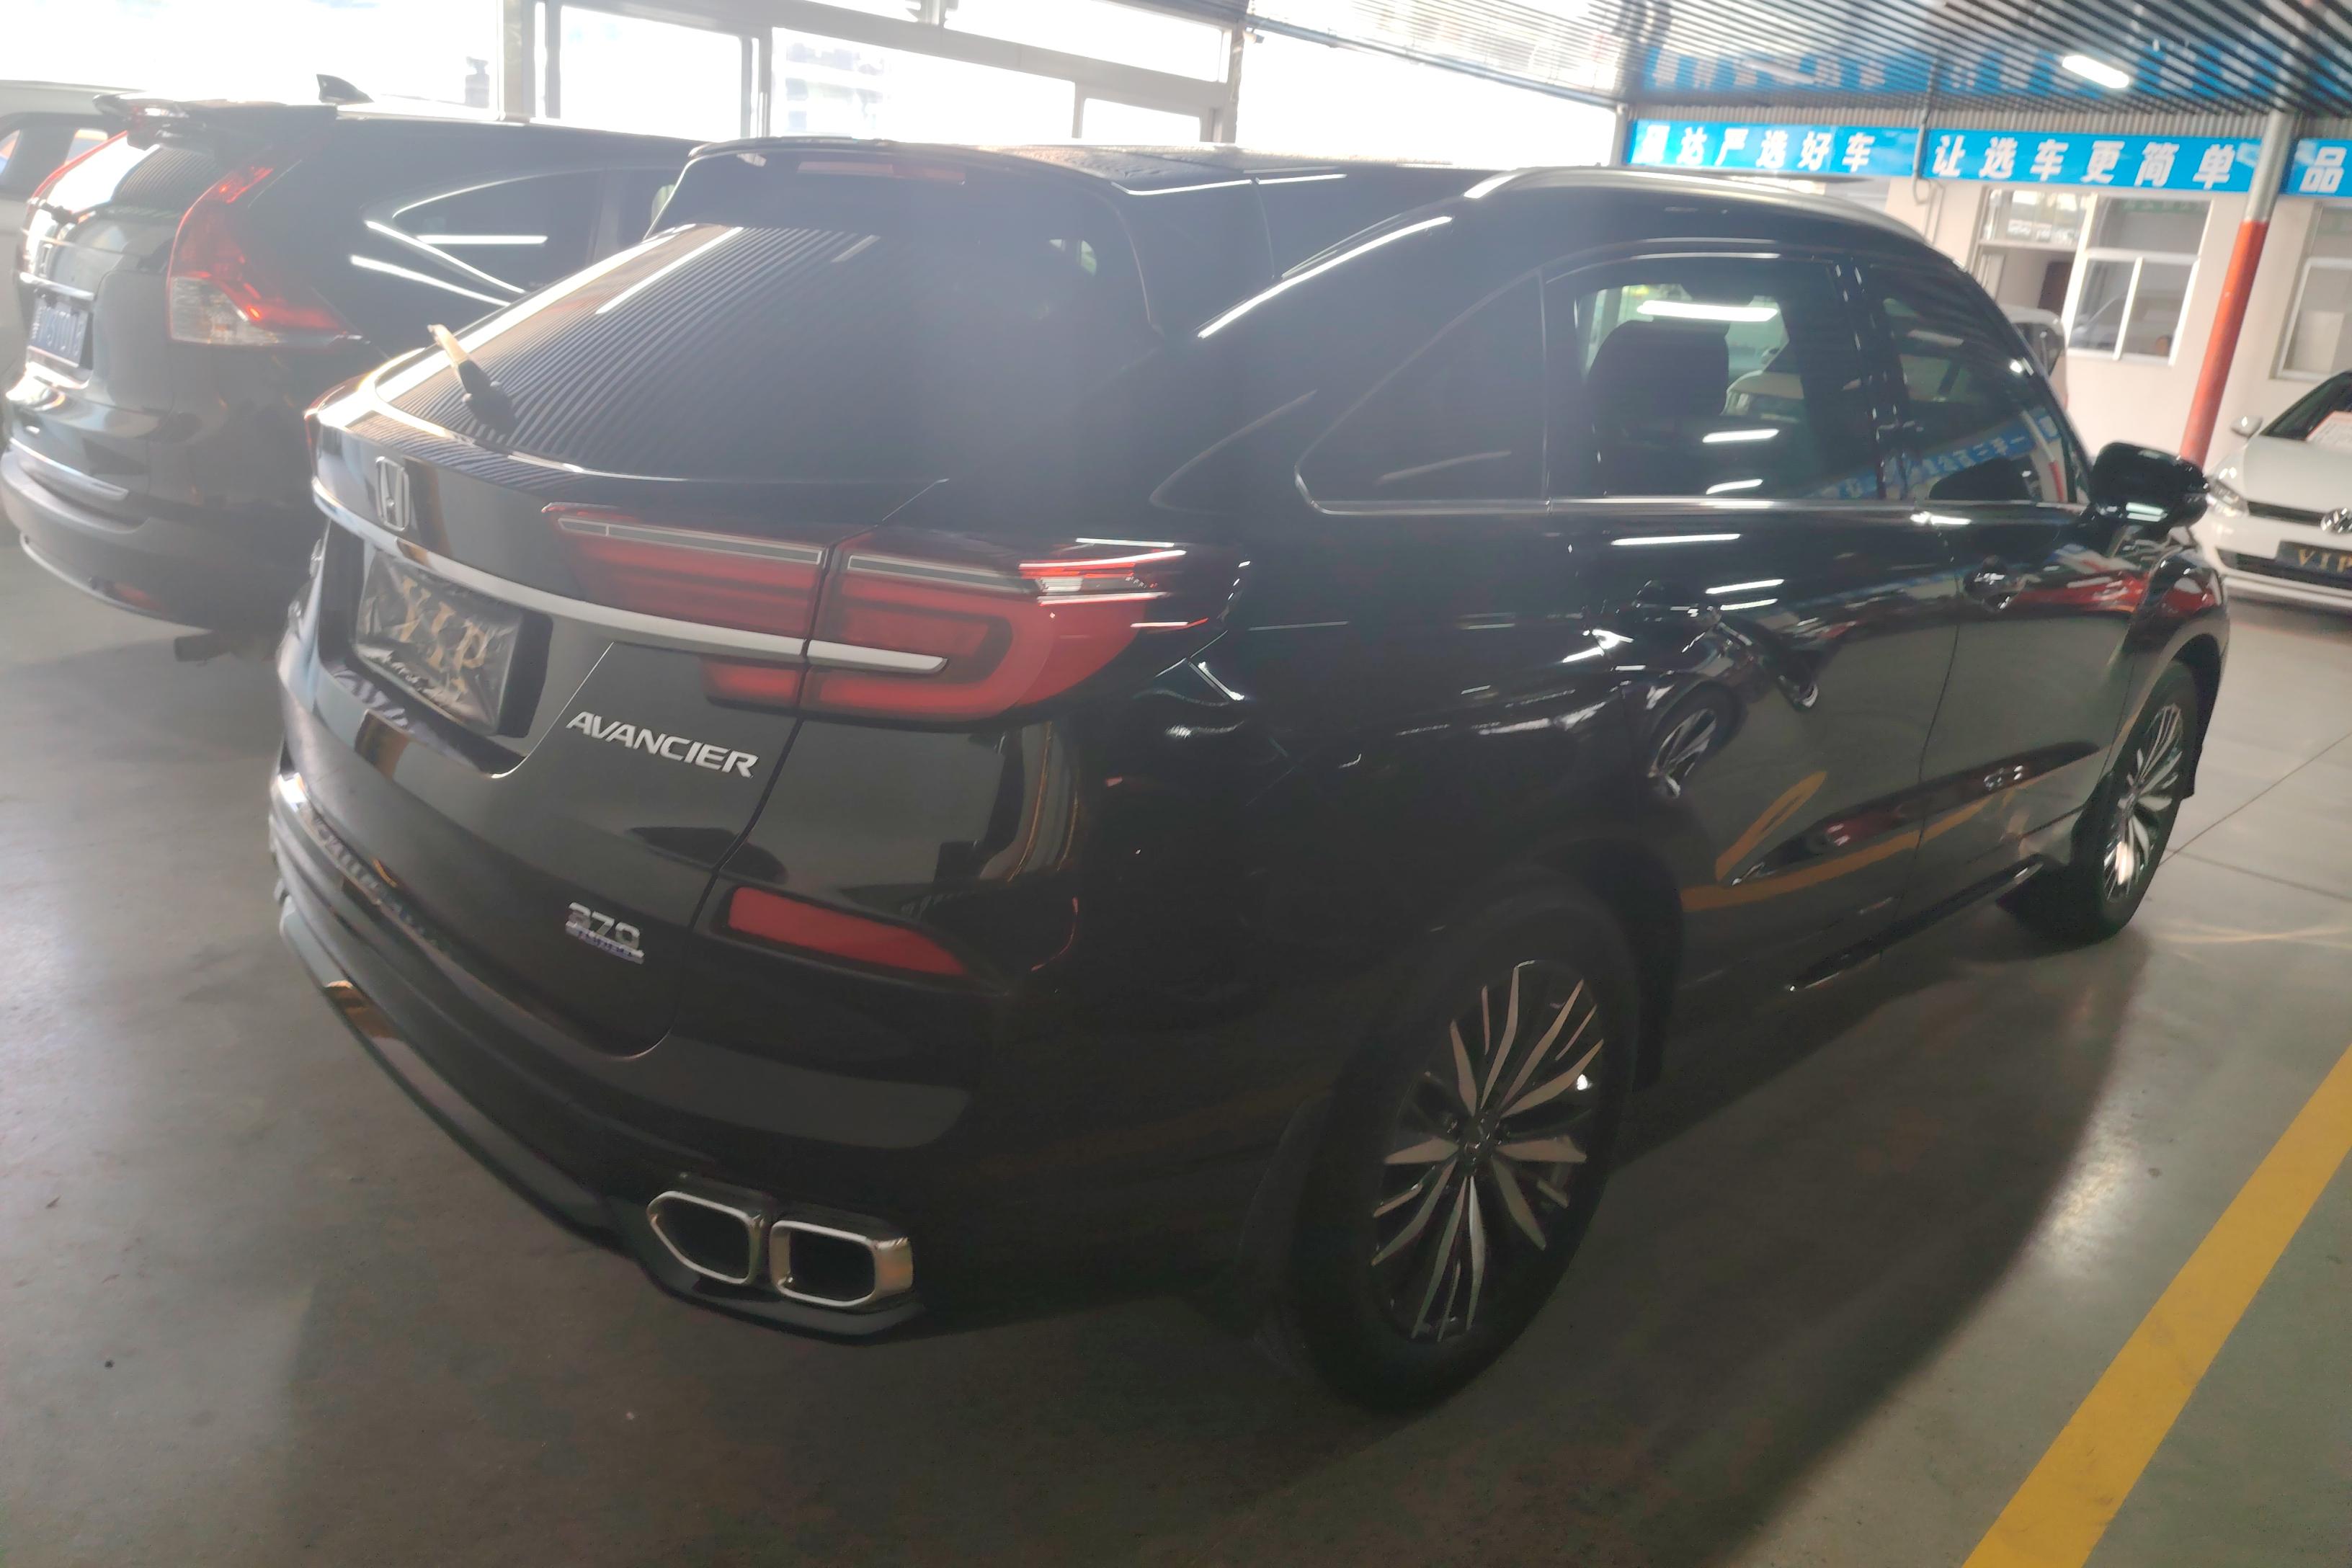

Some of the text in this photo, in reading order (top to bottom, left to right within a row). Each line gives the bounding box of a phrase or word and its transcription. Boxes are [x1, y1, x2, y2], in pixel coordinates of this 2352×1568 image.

[1632, 124, 1875, 172] 达严选好车
[1931, 135, 2235, 190] 让选车更简单
[2299, 146, 2347, 193] 品
[566, 711, 759, 778] AVANCIER
